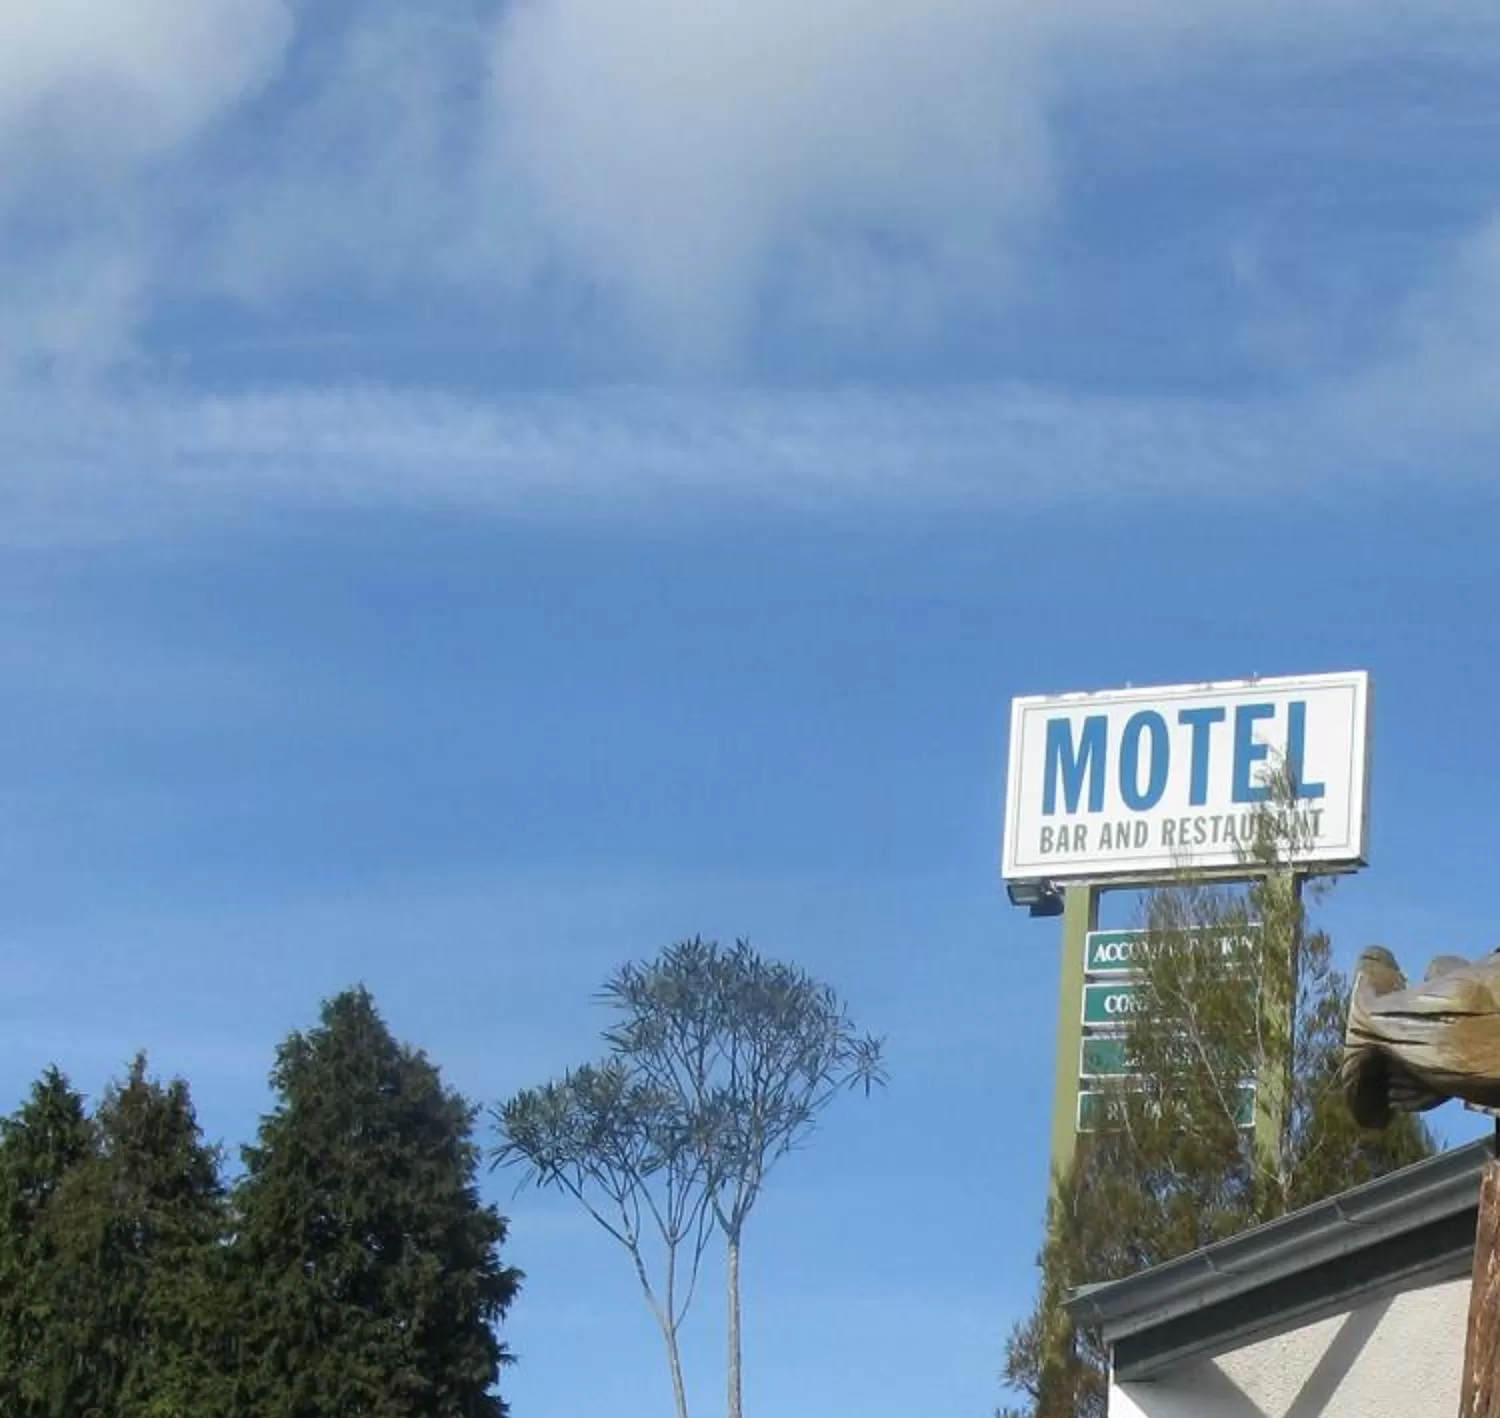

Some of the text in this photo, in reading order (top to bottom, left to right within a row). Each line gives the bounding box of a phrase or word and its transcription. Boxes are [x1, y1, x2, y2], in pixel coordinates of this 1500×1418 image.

[1042, 700, 1325, 816] MOTEL
[1040, 808, 1325, 855] BAR AND RESTAUANT
